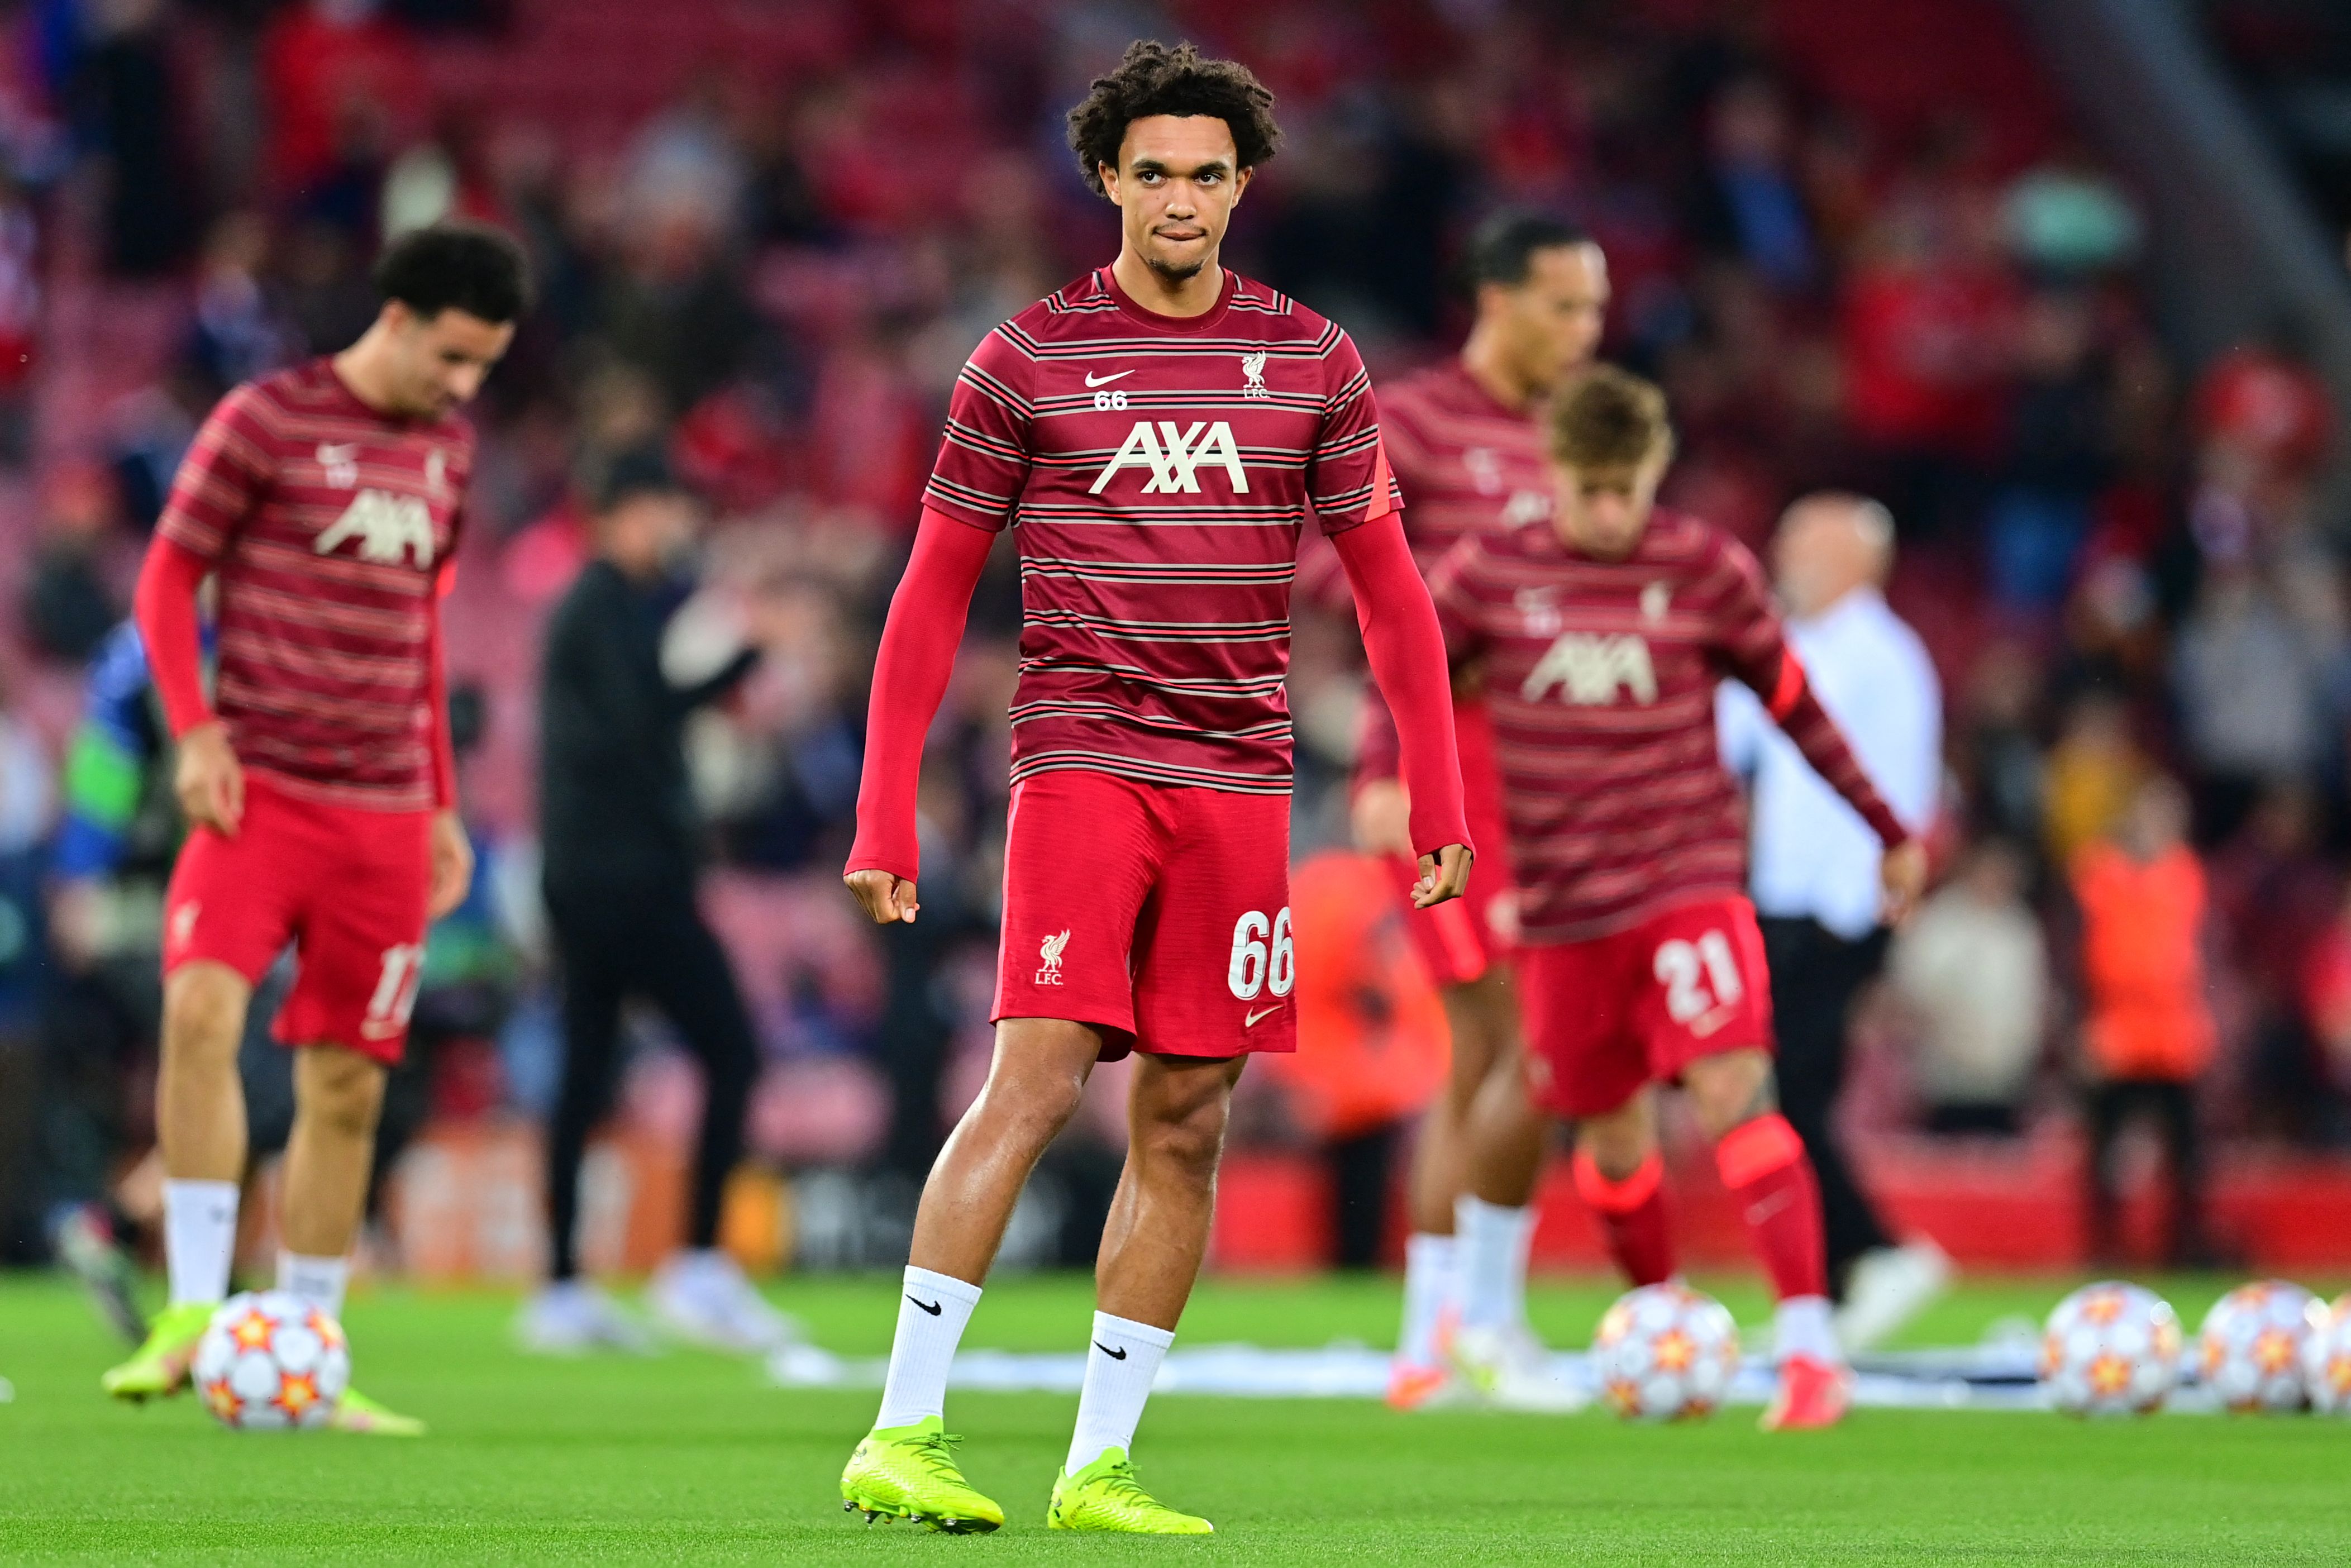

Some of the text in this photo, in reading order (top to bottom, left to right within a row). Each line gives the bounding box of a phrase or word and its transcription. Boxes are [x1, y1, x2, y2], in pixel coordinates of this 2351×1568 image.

[1094, 390, 1128, 412] 66
[1088, 421, 1250, 494] AXA
[314, 487, 435, 570] AXA
[1520, 630, 1659, 706] AXA
[1228, 906, 1295, 1000] 66
[1652, 928, 1744, 1025] 21
